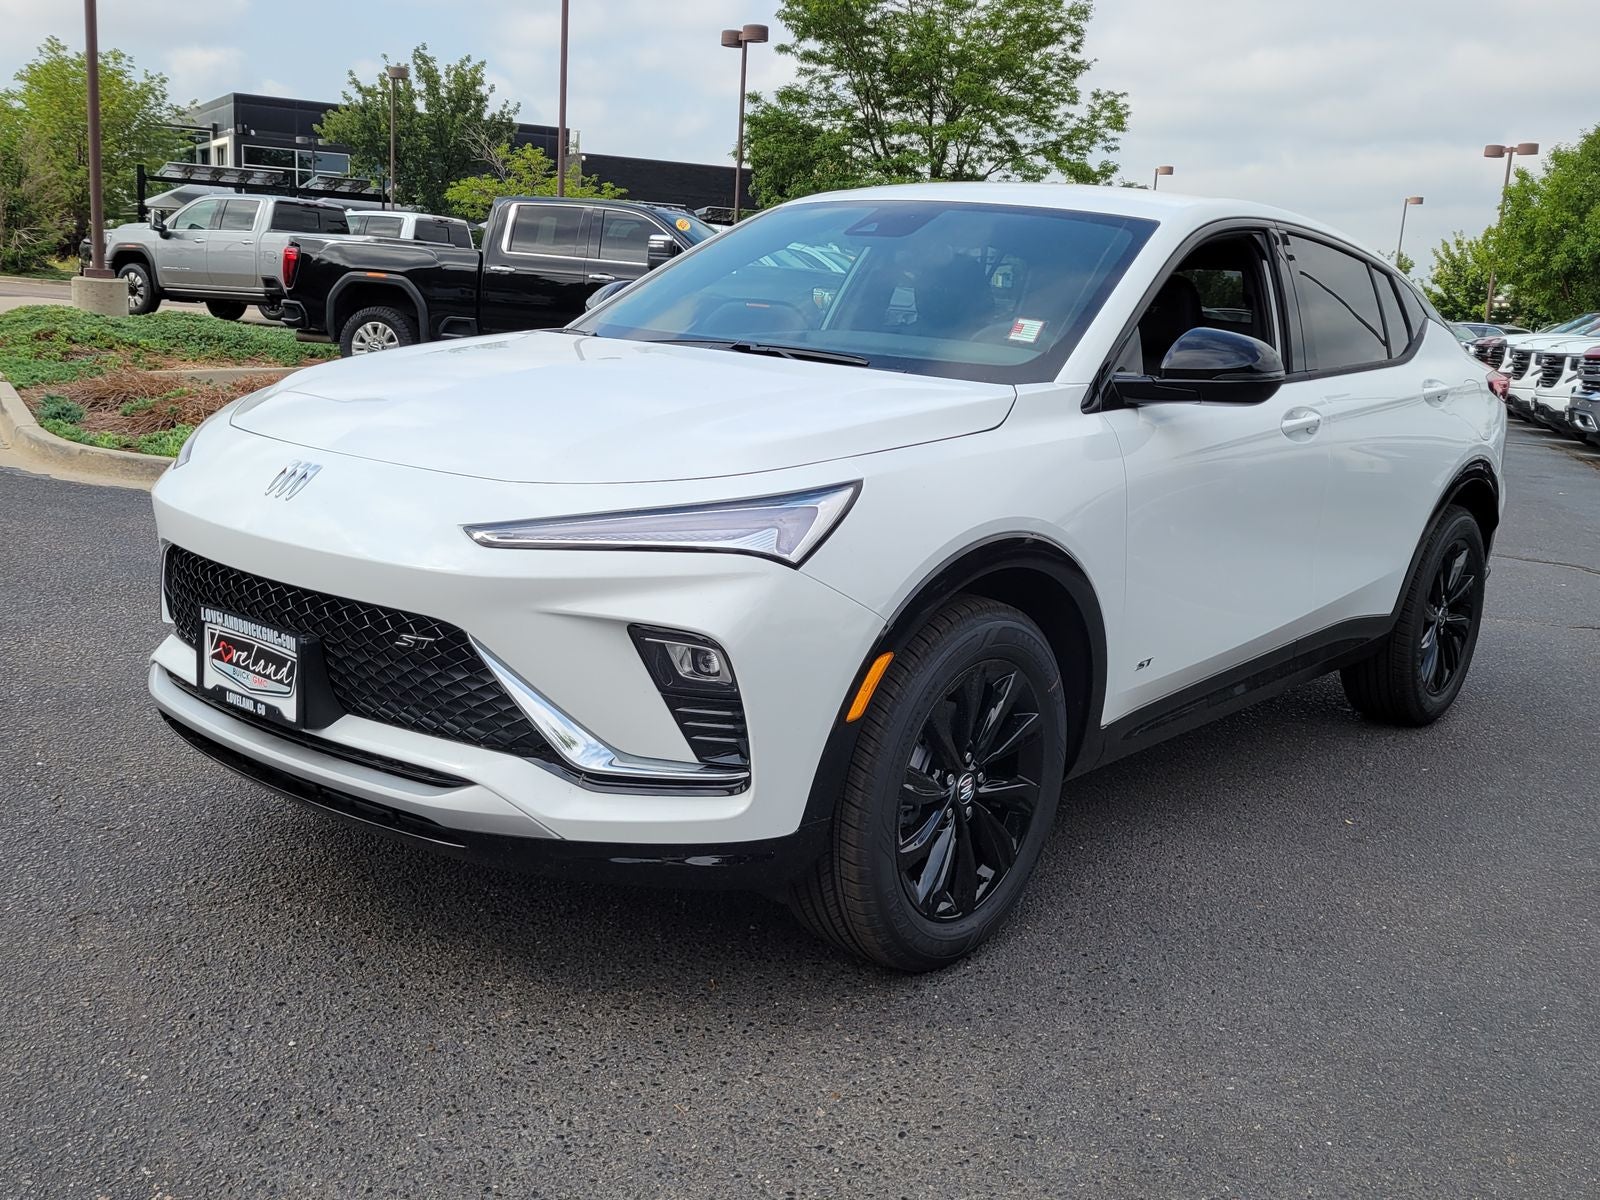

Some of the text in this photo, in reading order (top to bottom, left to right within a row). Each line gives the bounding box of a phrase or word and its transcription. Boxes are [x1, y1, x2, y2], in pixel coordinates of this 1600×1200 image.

[395, 634, 435, 650] ST
[1134, 656, 1154, 671] ST
[232, 667, 268, 688] BUICK GMC
[257, 702, 266, 716] CO
